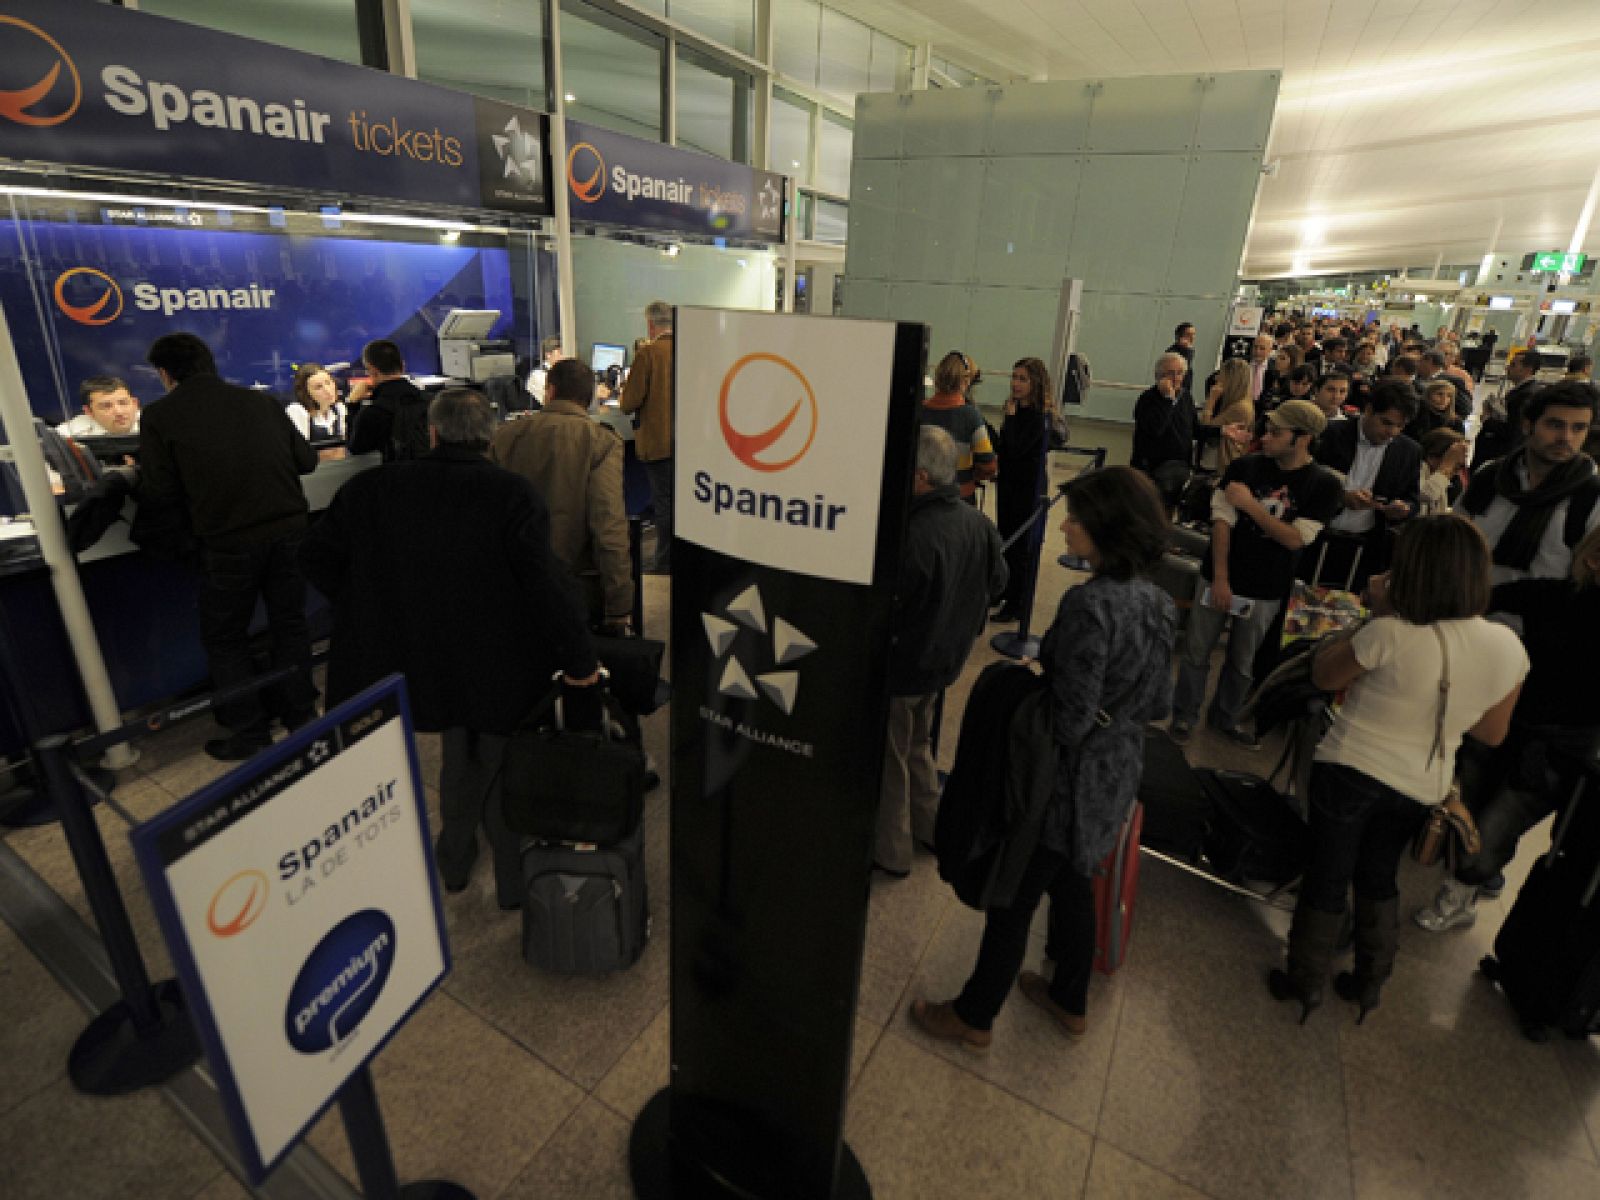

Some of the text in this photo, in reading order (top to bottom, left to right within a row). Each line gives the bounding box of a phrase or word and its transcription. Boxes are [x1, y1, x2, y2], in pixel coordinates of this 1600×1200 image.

[101, 64, 464, 167] Spanair tickets
[611, 164, 694, 204] Spanair
[134, 282, 275, 316] Spanair
[694, 471, 847, 531] Spanair
[277, 776, 399, 881] Spanair
[284, 804, 402, 905] LA DE TOTS
[294, 931, 389, 1036] premium
